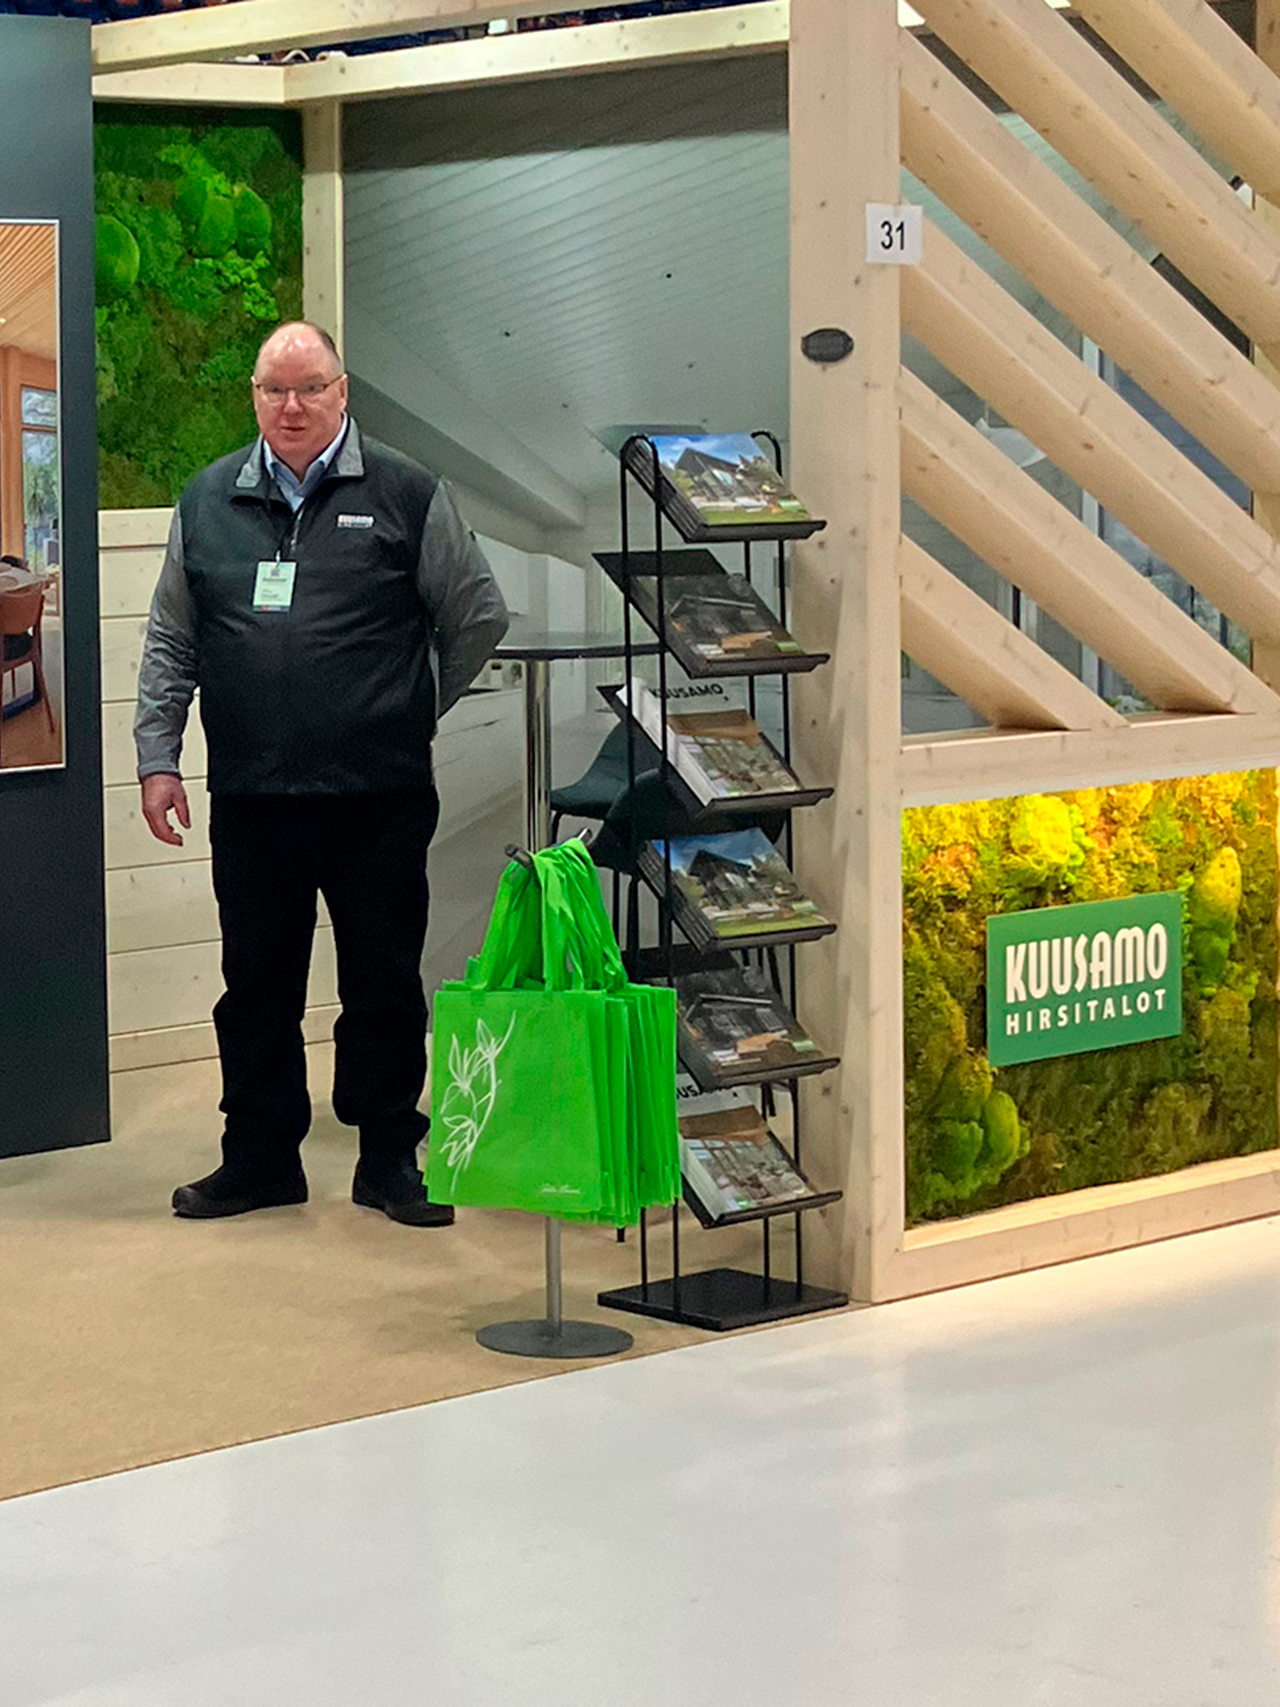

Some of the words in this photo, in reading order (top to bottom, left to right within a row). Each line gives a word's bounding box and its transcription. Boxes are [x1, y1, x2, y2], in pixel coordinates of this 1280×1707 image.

[881, 220, 905, 250] 31
[1006, 922, 1168, 1004] KUUSAMO
[1006, 989, 1166, 1036] HIRSITALOT
